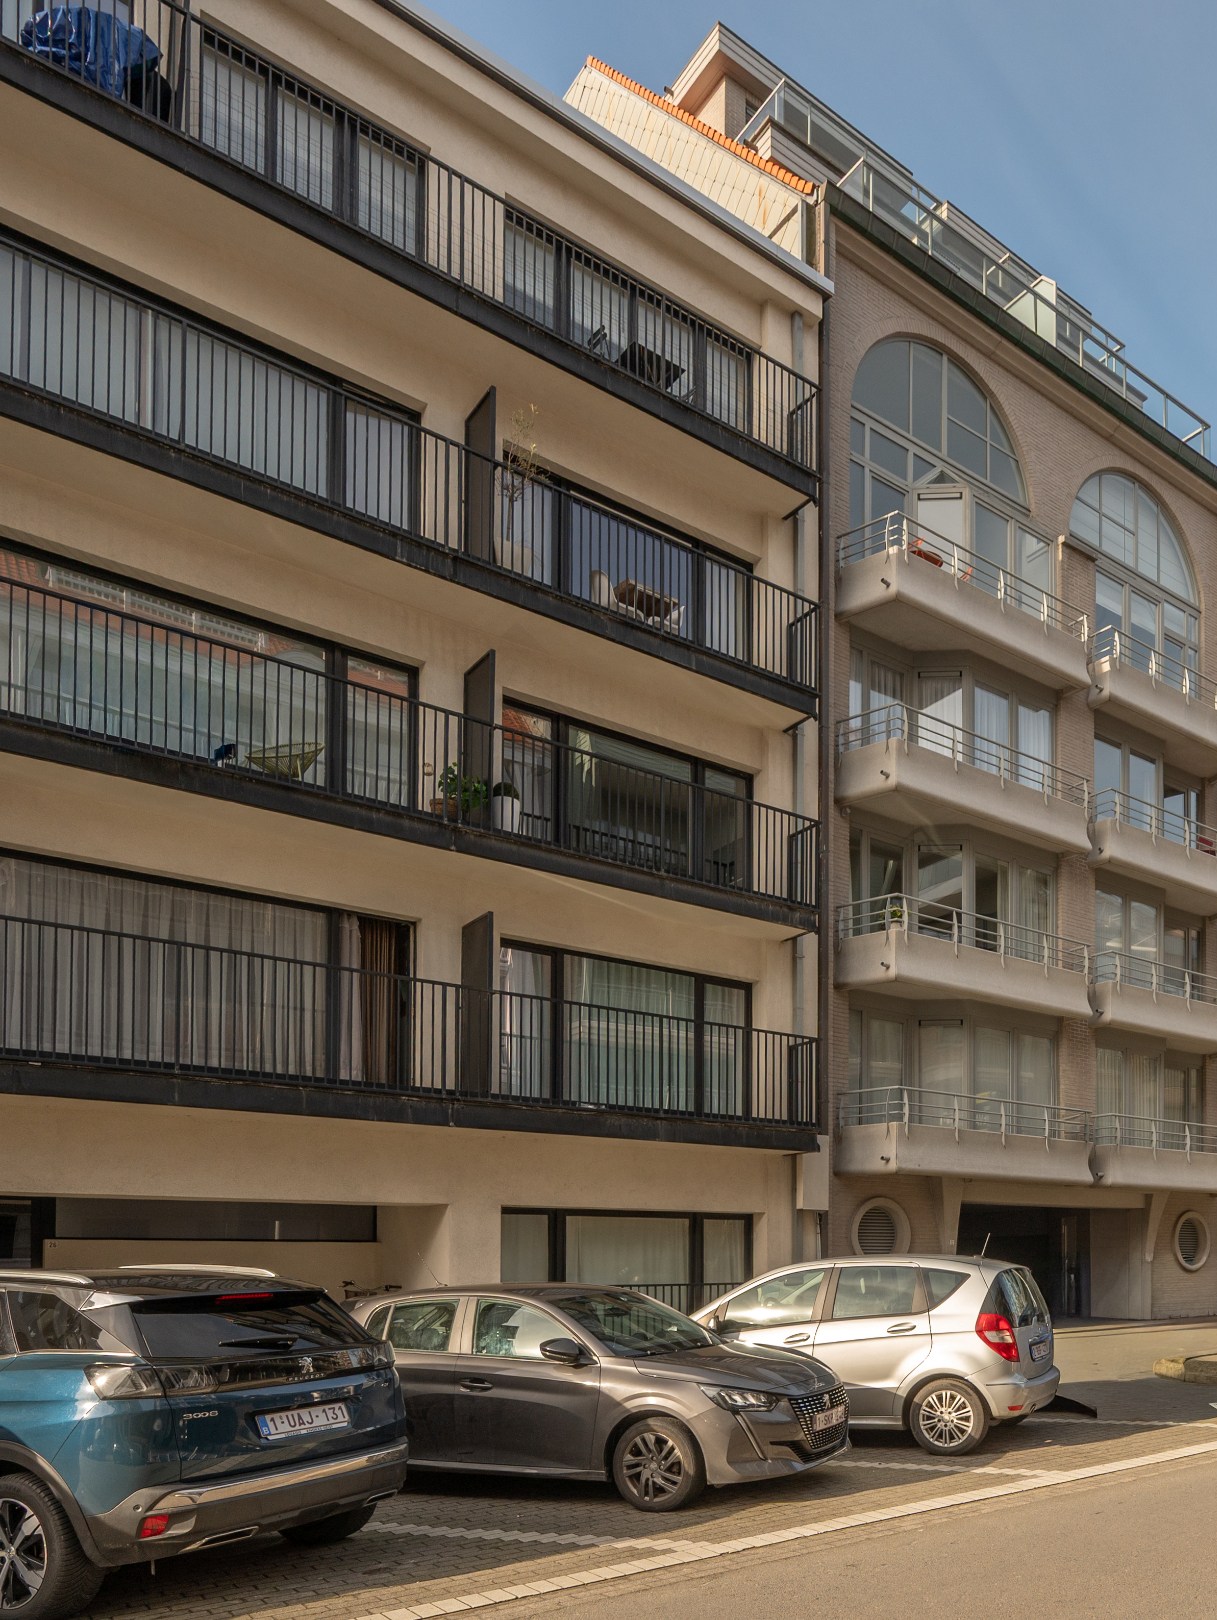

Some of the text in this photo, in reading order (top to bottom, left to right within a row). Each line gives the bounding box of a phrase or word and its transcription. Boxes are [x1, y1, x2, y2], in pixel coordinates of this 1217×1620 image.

[288, 1372, 325, 1382] PEUGEOT
[182, 1410, 219, 1420] 3008
[263, 1426, 270, 1434] B
